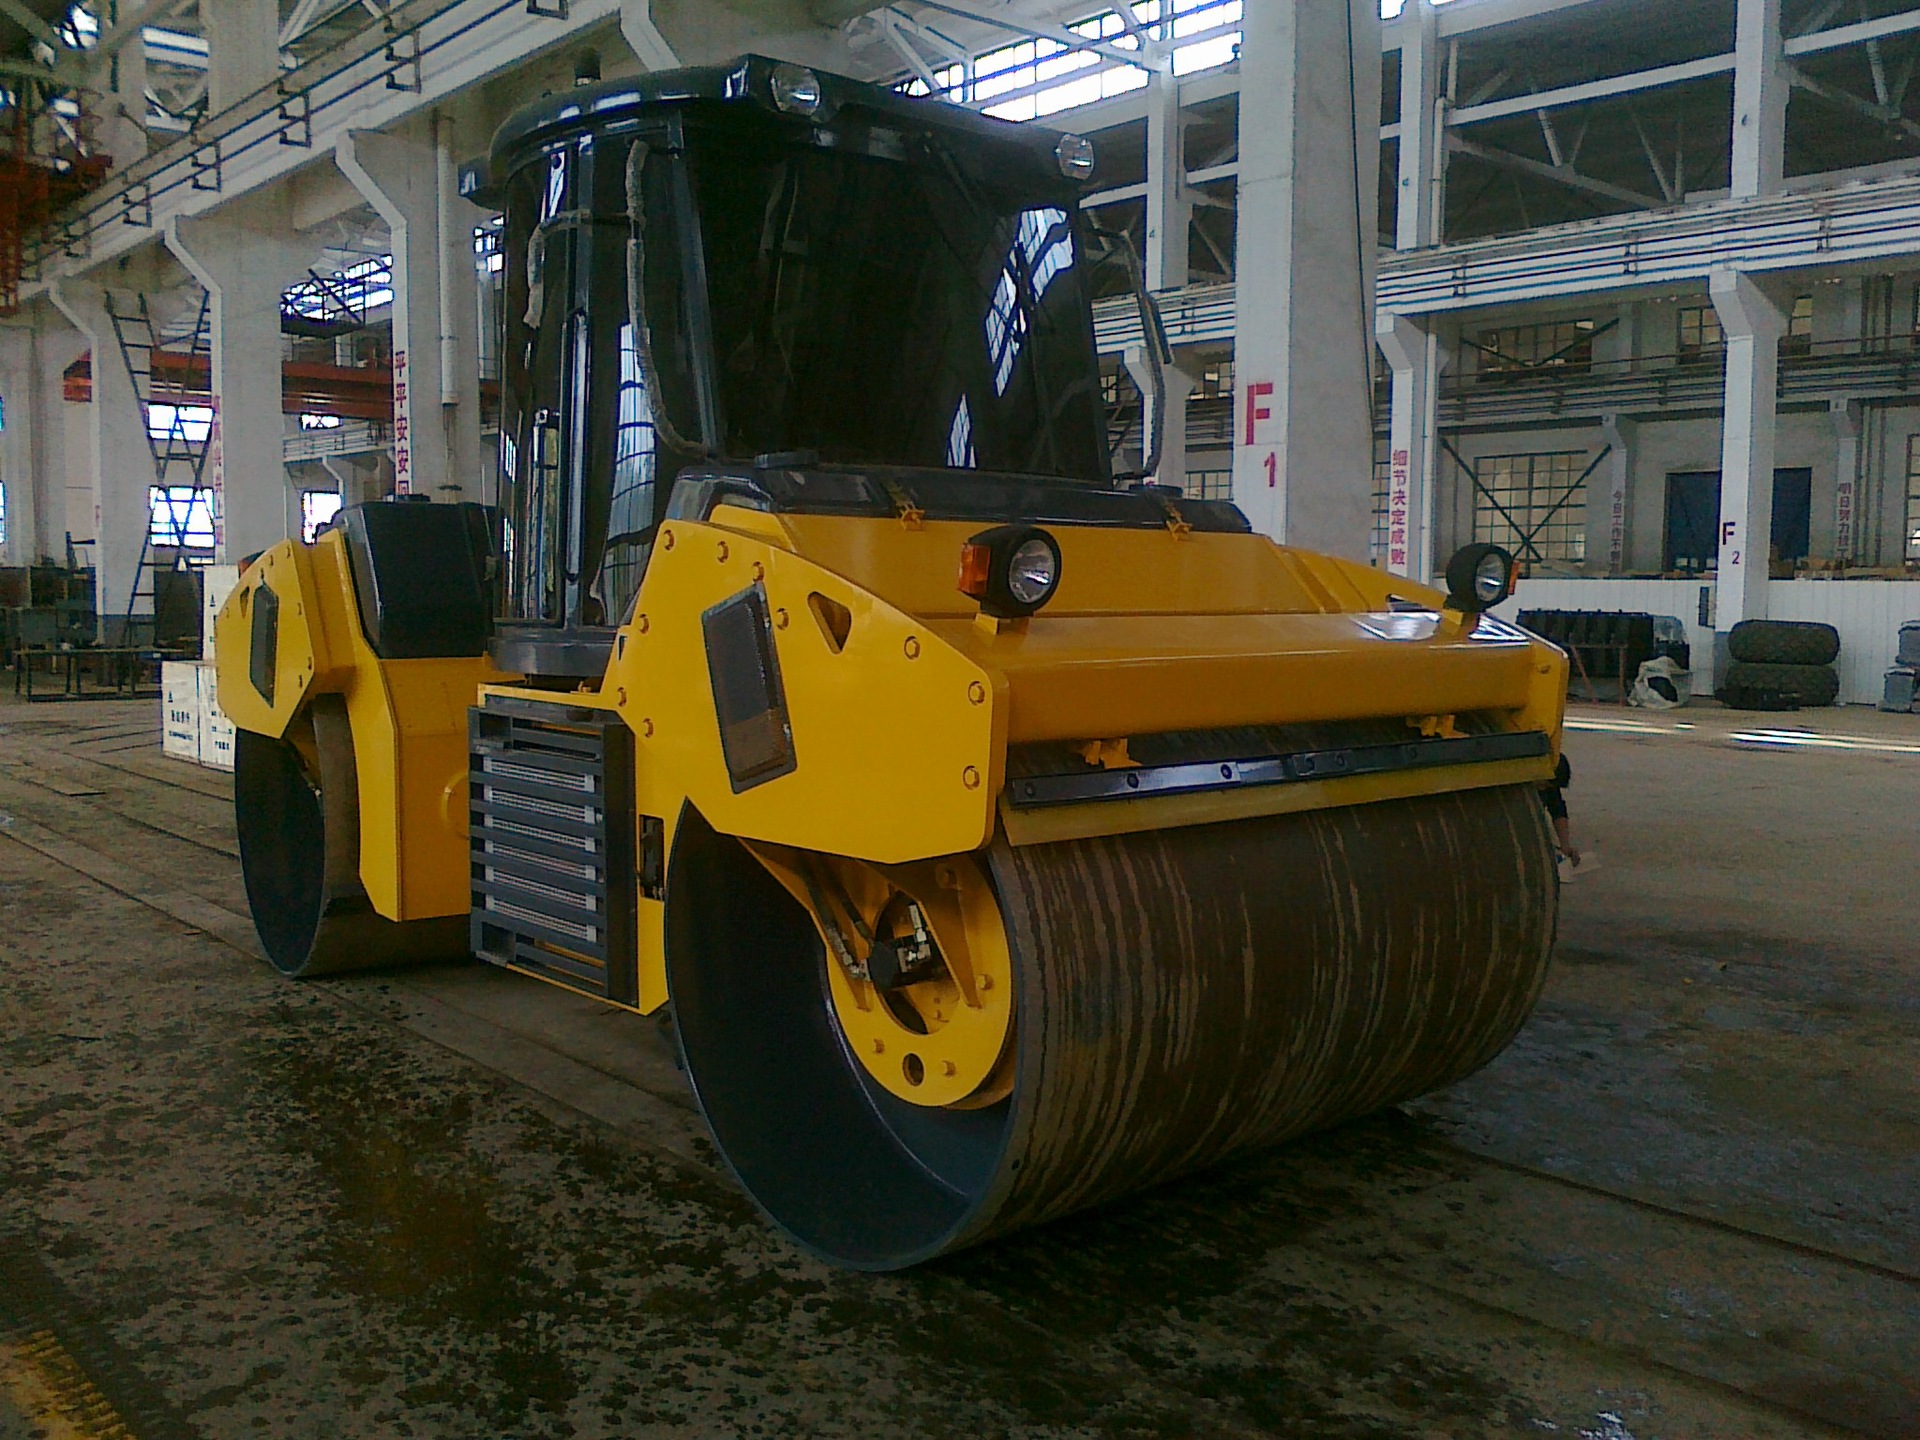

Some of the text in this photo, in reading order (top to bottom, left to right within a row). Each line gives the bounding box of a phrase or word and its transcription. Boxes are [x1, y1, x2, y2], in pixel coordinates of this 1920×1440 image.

[1246, 383, 1273, 445] F
[1264, 452, 1276, 487] 1
[1390, 450, 1408, 565] 细节决定成败
[1723, 522, 1735, 545] F
[1732, 551, 1740, 564] 2
